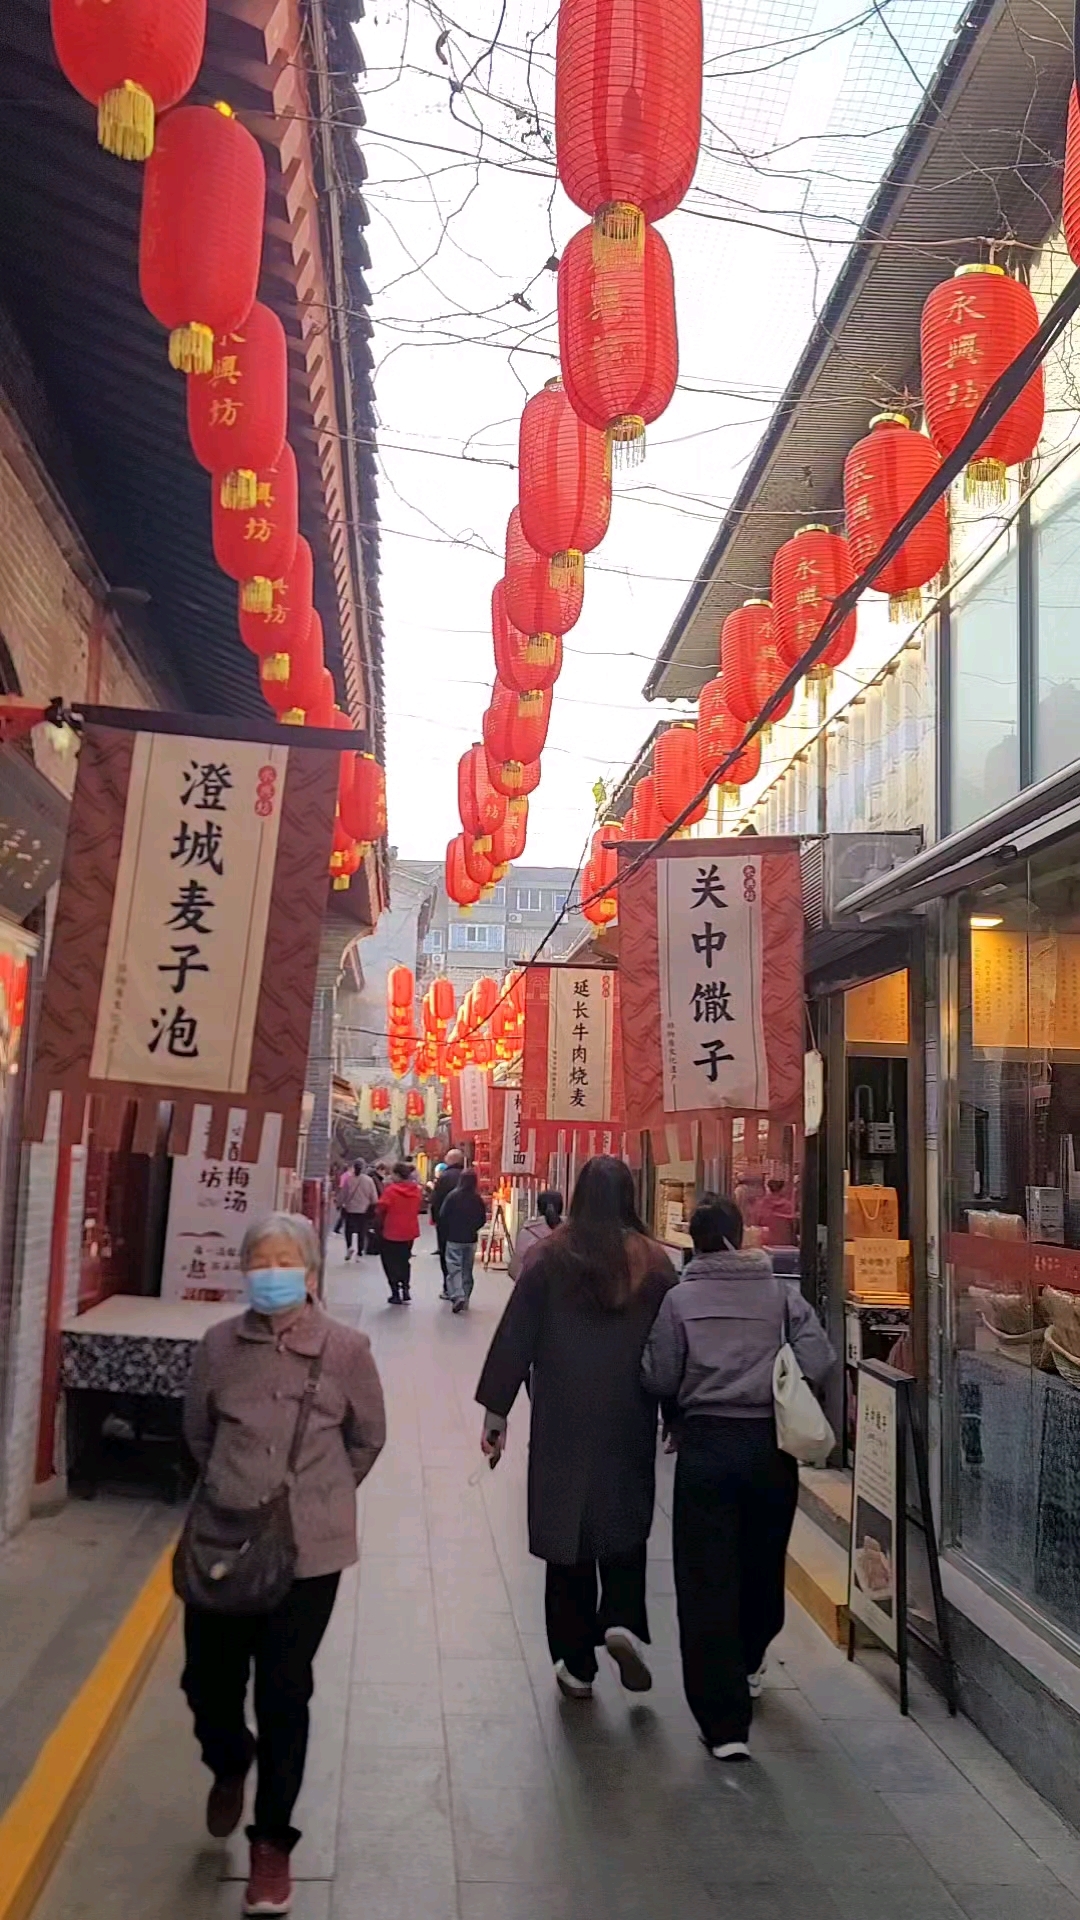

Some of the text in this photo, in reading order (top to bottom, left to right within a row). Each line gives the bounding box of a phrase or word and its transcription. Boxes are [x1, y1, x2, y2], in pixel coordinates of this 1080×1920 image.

[146, 759, 233, 1058] 澄城麦子泡
[689, 864, 737, 1083] 关中馓子
[569, 978, 590, 1107] 延长牛肉烧麦
